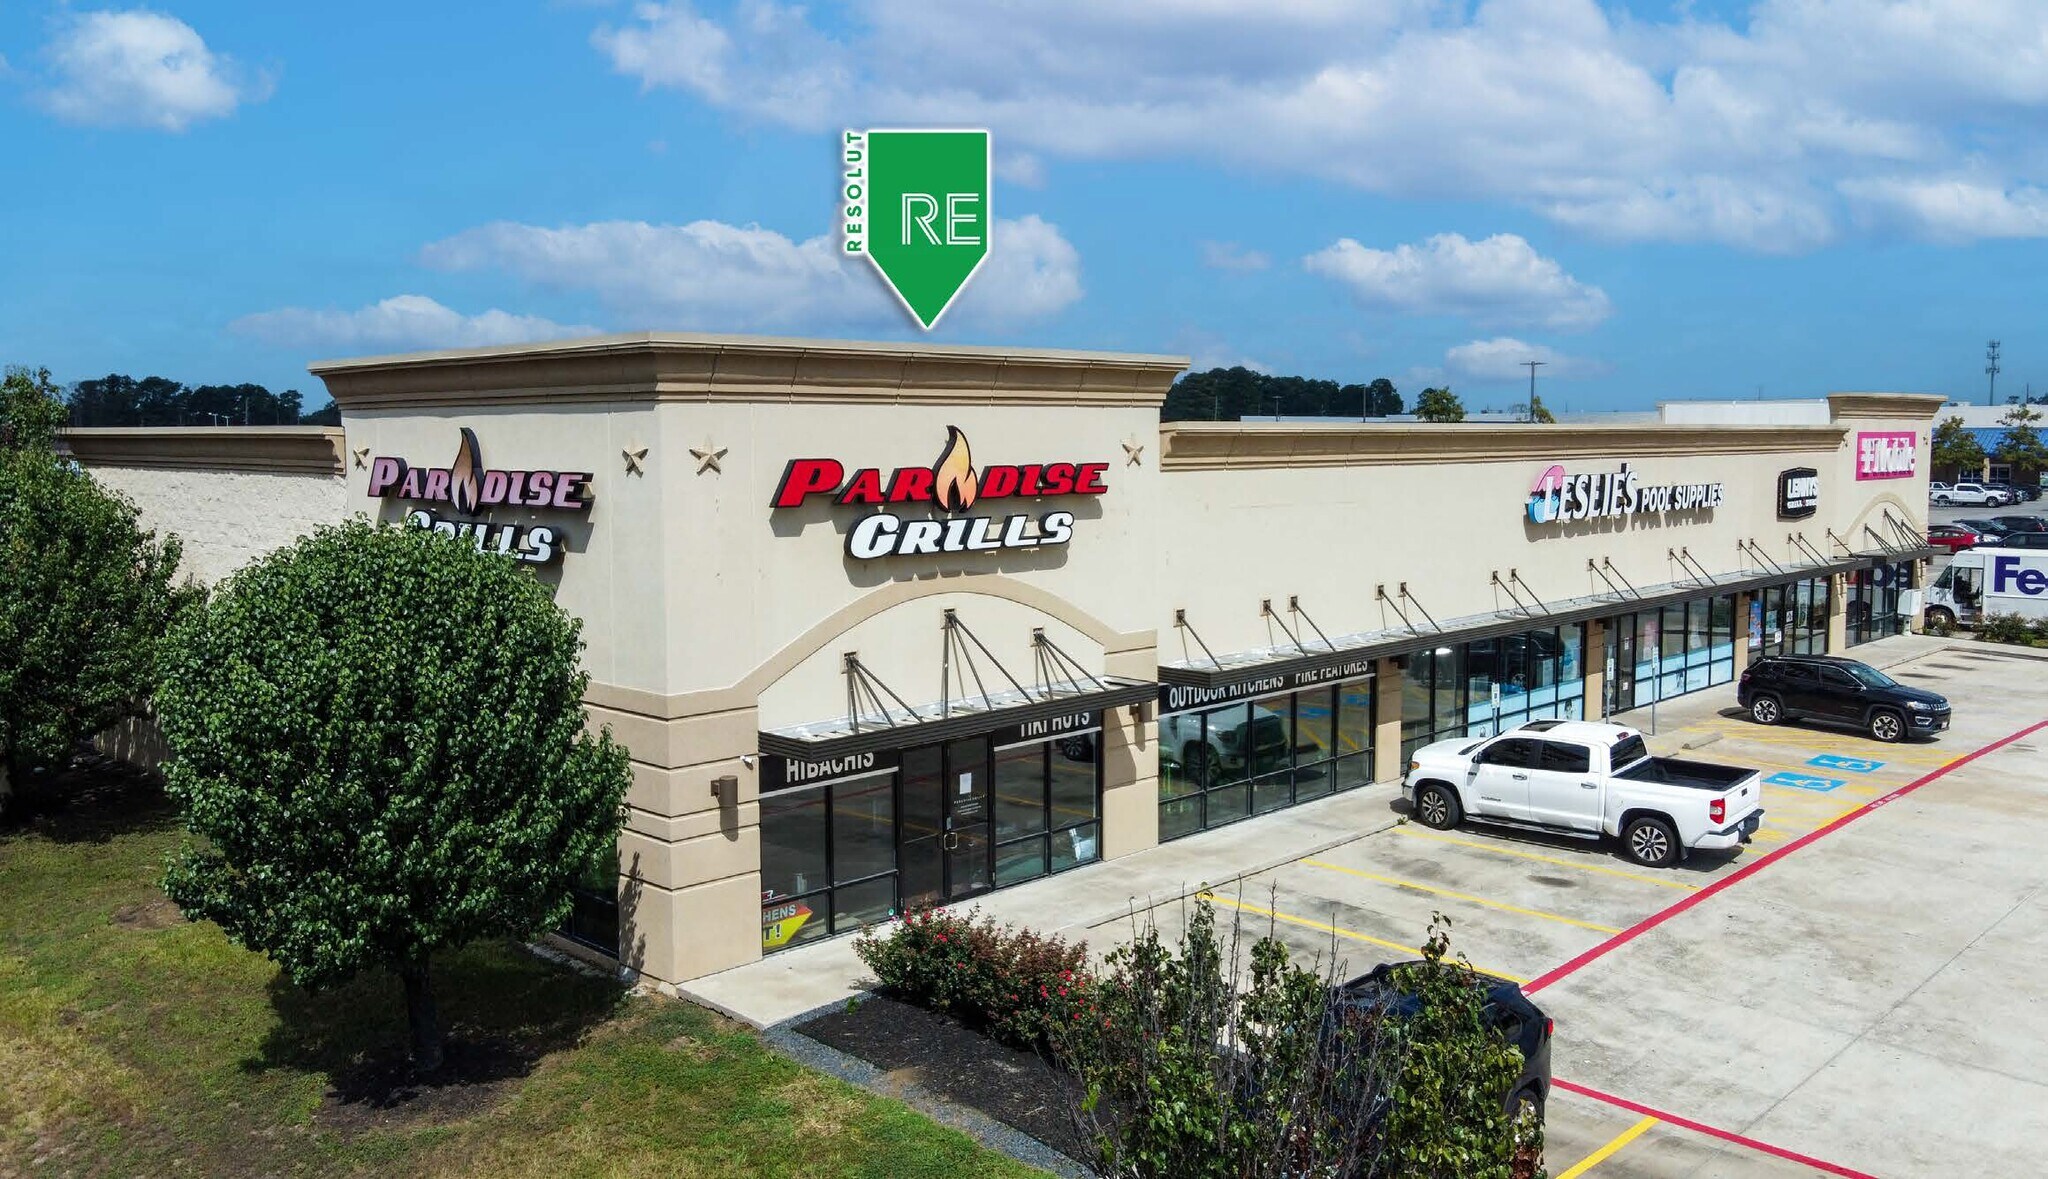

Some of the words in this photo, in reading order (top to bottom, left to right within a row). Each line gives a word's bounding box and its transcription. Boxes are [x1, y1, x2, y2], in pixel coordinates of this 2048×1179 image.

[1641, 486, 1673, 514] POOL
[1674, 483, 1724, 511] SUPPLIES
[406, 509, 555, 563] LLS
[848, 512, 1075, 560] GRILLS
[1994, 556, 2048, 595] Fe
[1169, 685, 1226, 708] OUTDOOR
[1295, 670, 1318, 685] FIRE
[786, 752, 874, 783] HIBACHIS
